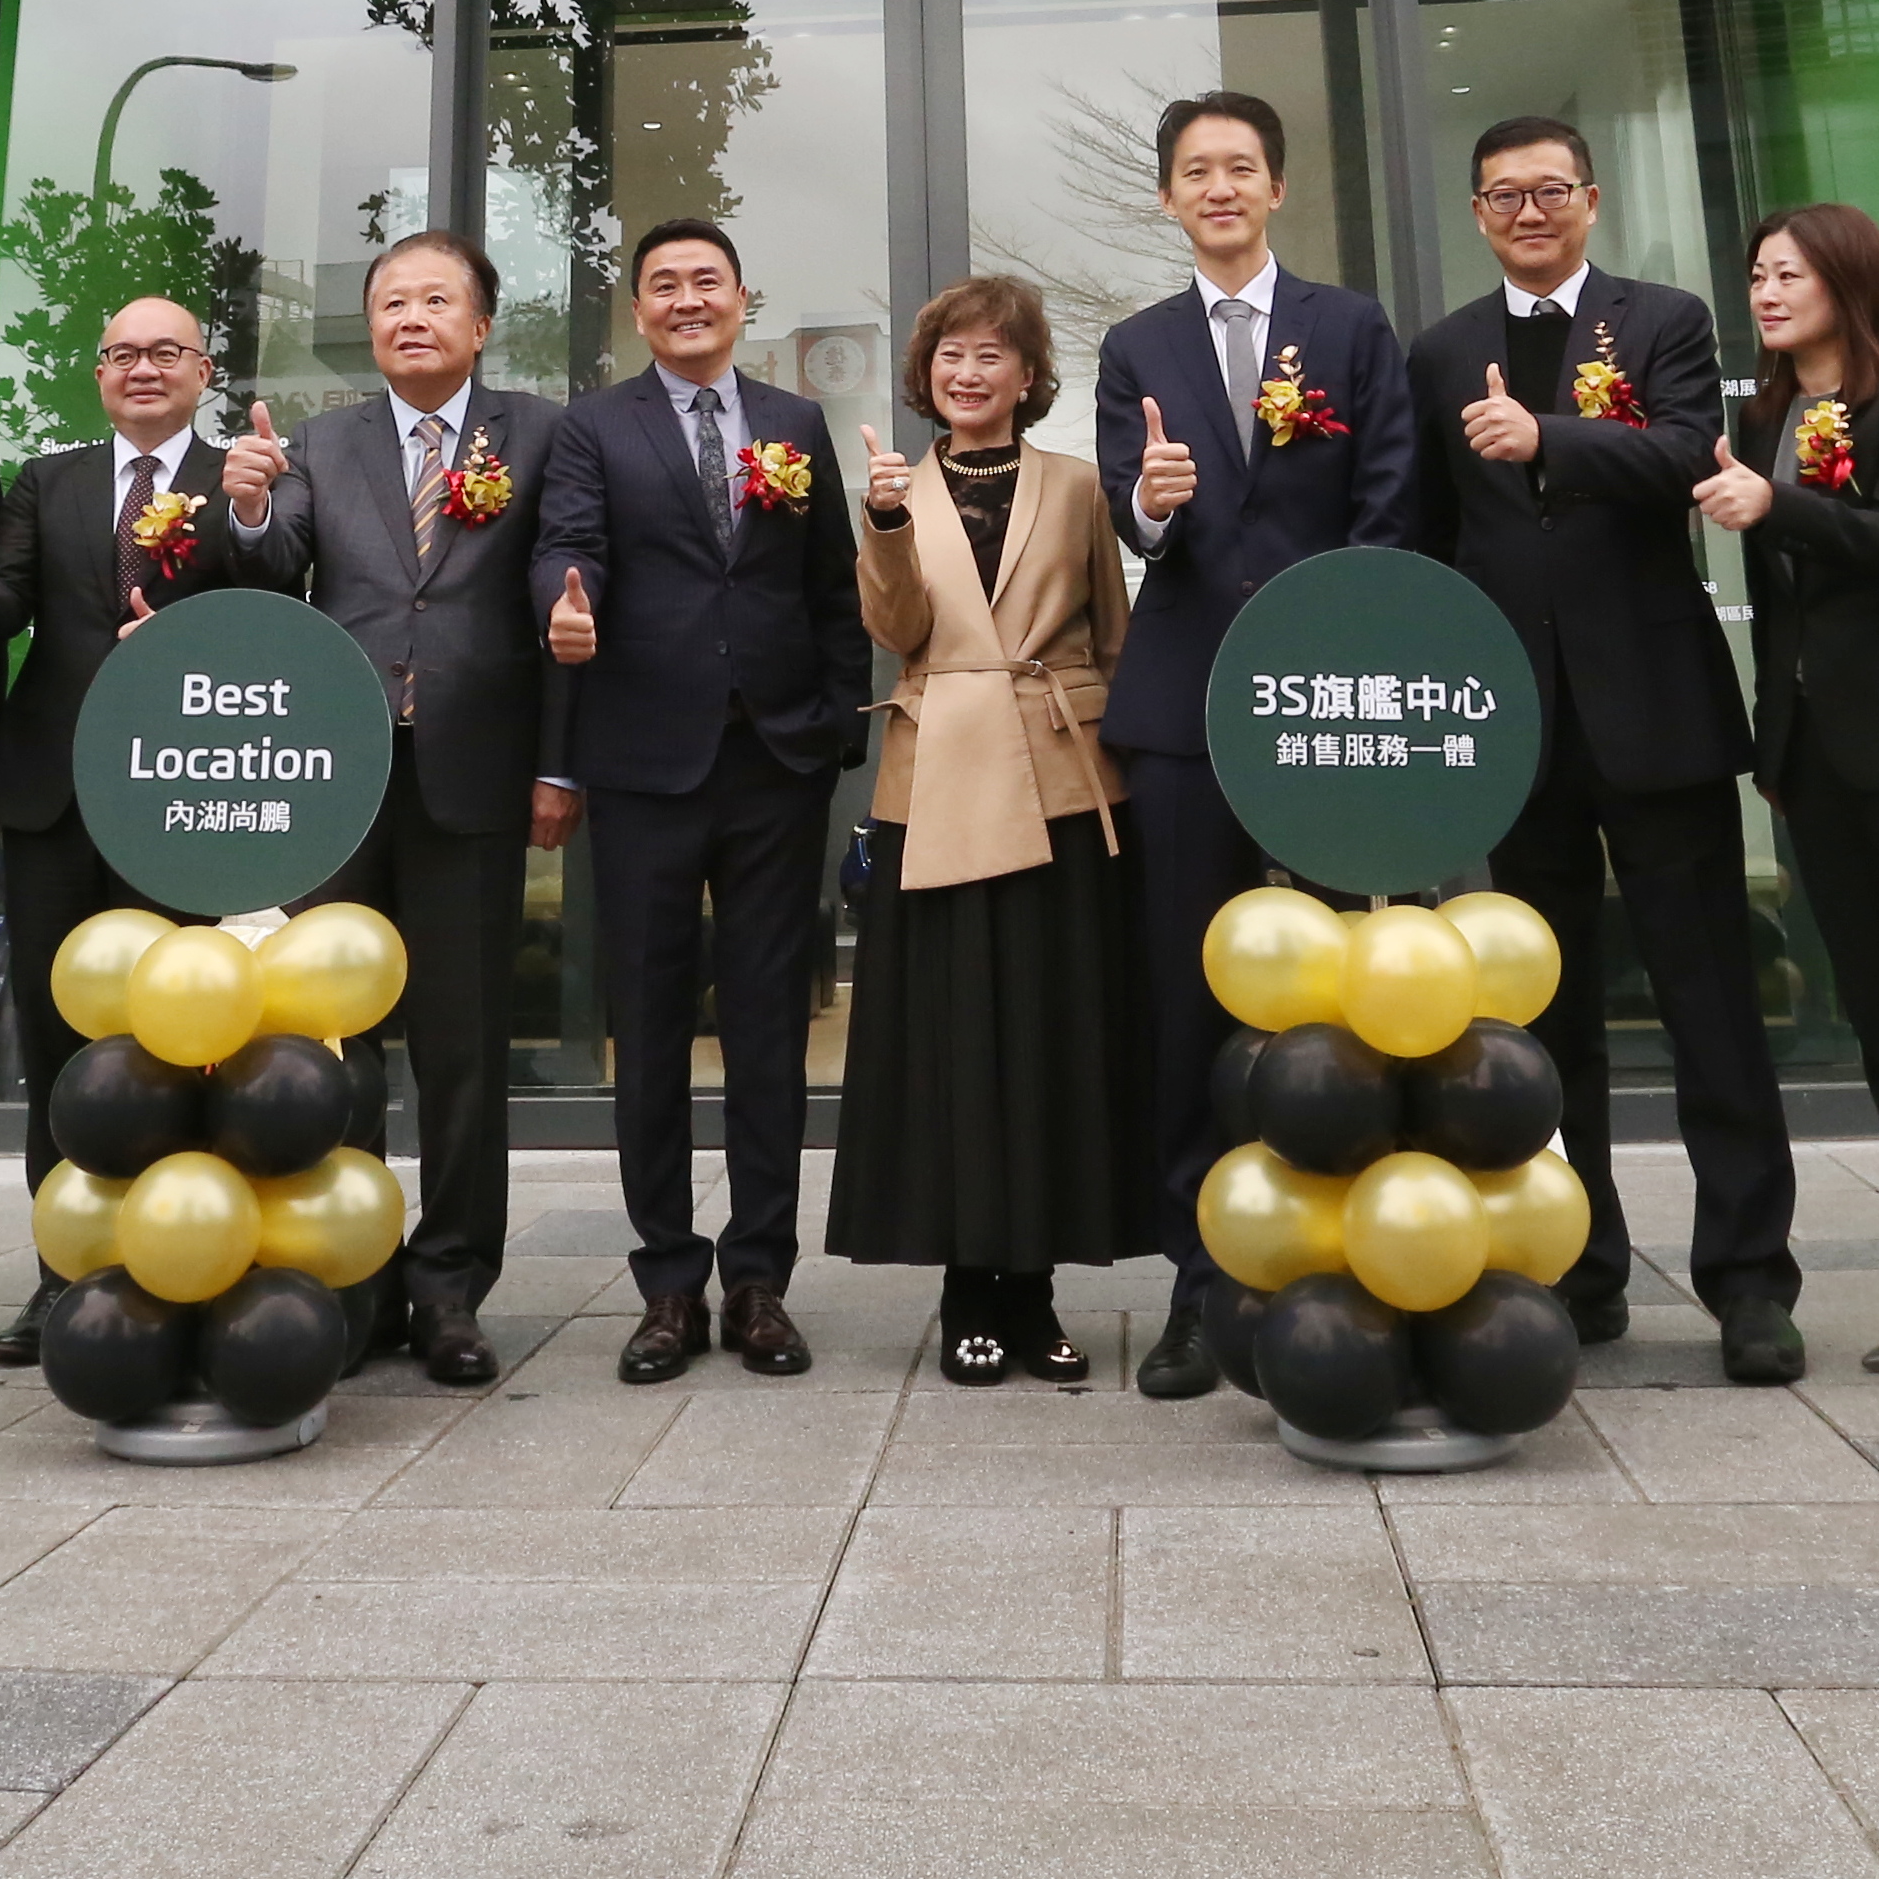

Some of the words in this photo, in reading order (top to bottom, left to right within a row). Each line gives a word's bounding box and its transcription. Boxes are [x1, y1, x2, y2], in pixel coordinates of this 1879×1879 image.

[1720, 378, 1757, 397] 湖展
[181, 674, 290, 716] Best
[1252, 674, 1497, 721] 3S旗艦中心
[130, 736, 332, 780] Location
[1276, 732, 1476, 767] 銷售服務一體
[165, 800, 291, 832] 內湖尚鵬
